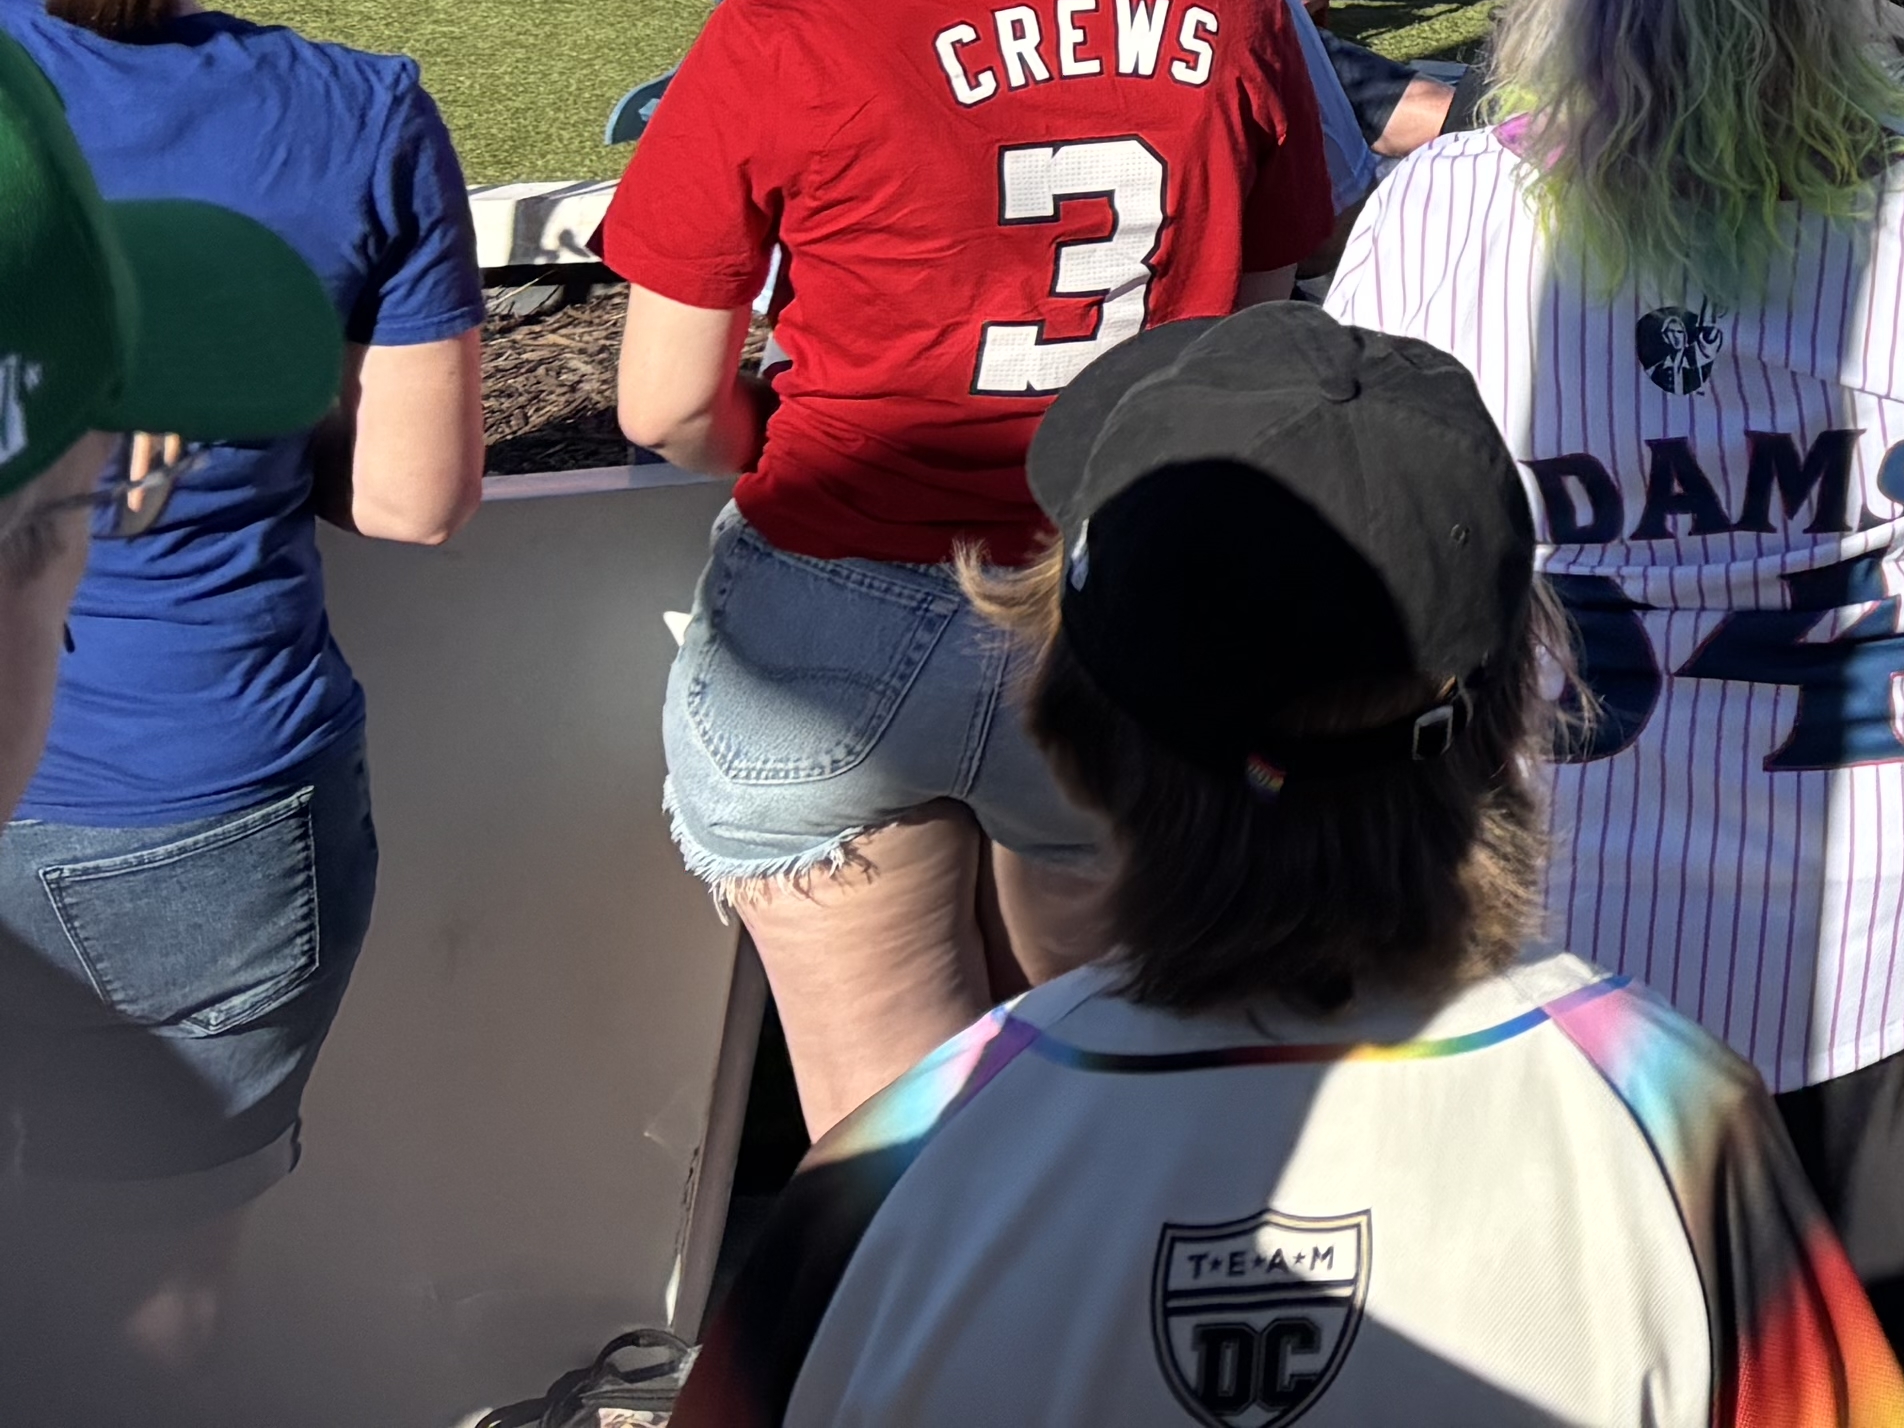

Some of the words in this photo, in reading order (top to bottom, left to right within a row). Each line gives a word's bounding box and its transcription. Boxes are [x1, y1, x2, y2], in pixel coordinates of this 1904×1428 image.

[969, 134, 1169, 398] 3
[1187, 1244, 1336, 1281] TEAM
[1192, 1316, 1323, 1418] DC
